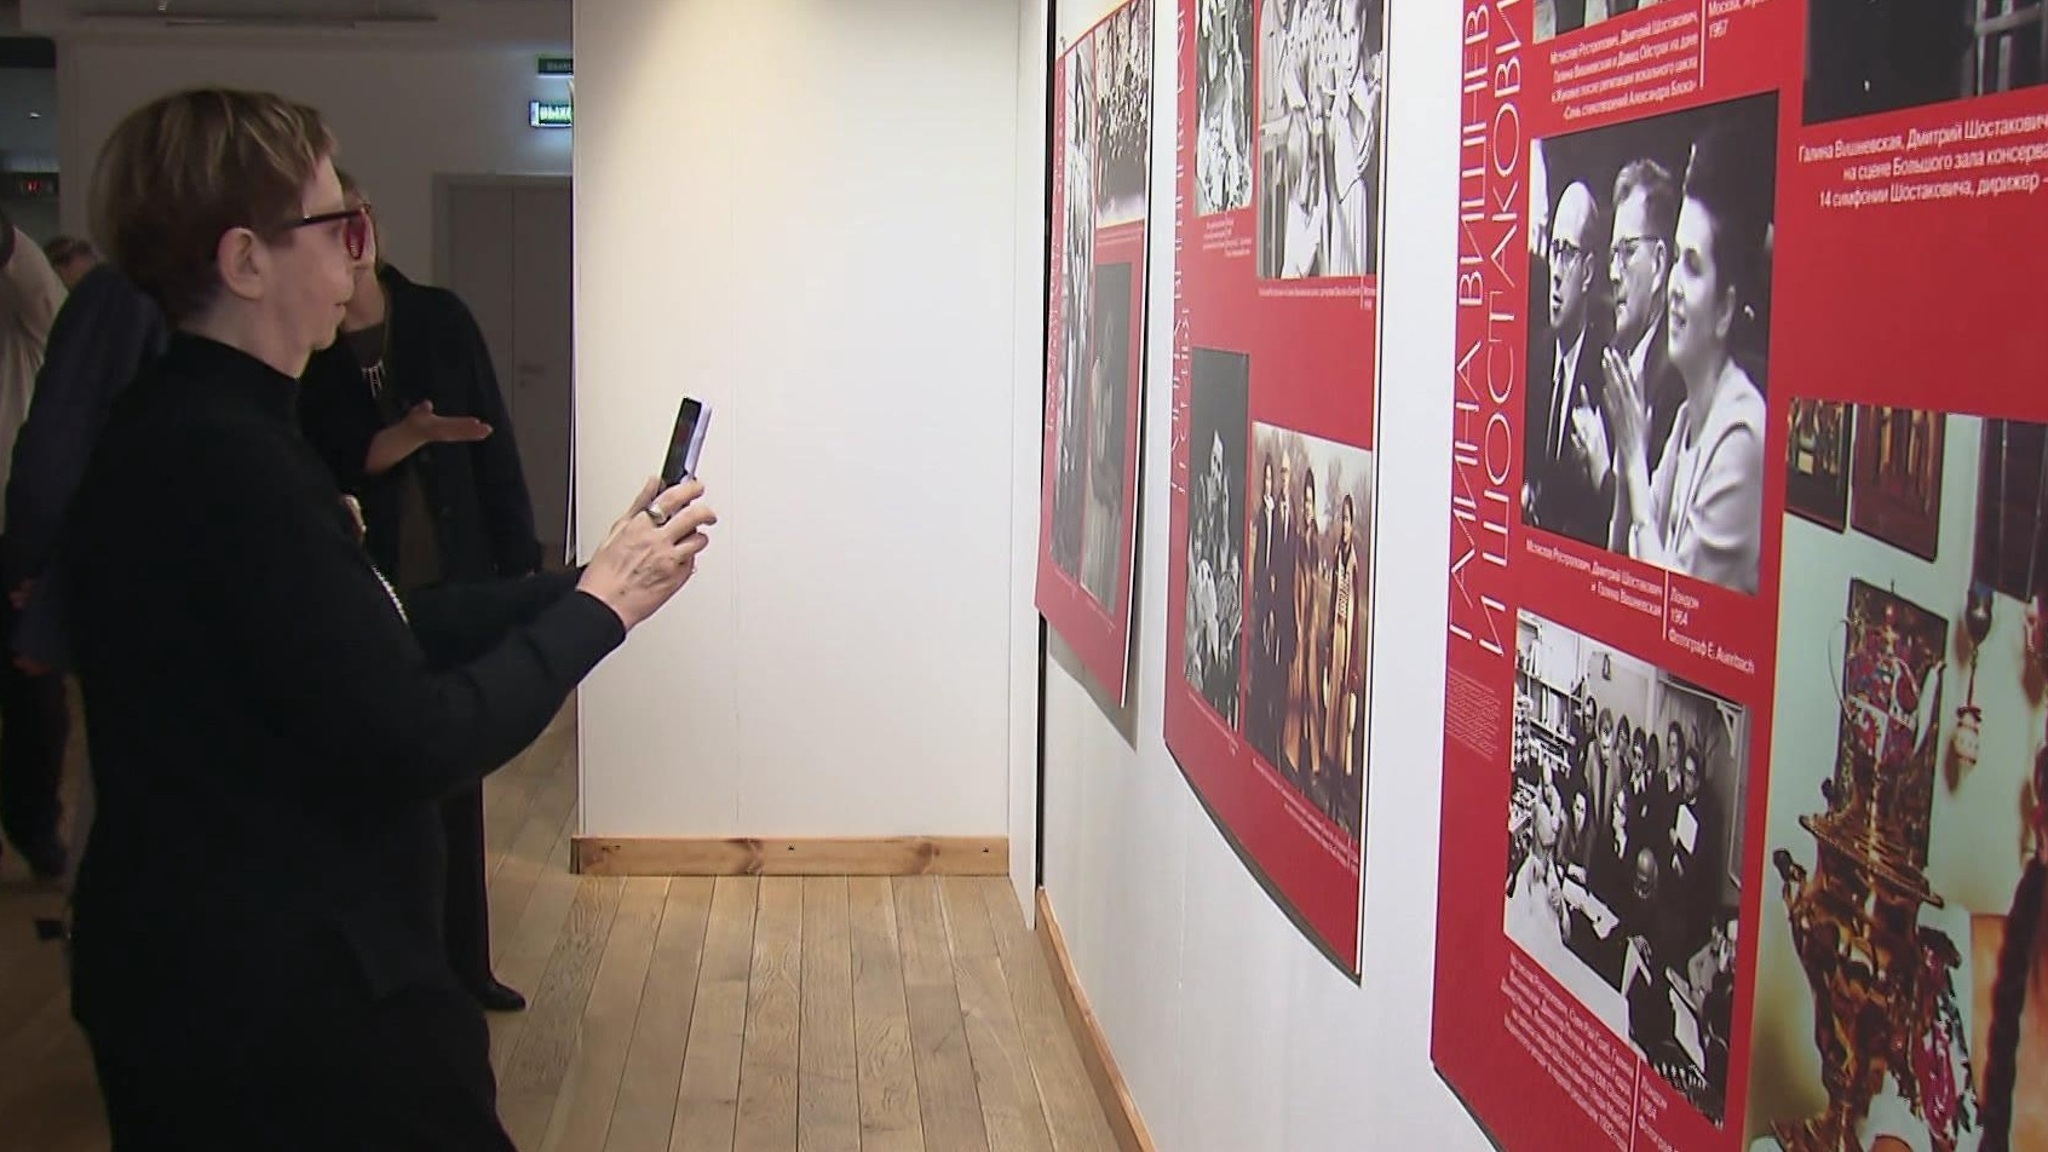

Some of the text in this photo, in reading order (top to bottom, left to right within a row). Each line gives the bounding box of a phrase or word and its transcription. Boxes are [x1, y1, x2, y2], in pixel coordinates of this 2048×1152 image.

[1799, 143, 1833, 162] Галина
[1907, 123, 1962, 150] Дмитрий
[1843, 167, 1857, 181] на
[1858, 161, 1892, 181] сцене
[1893, 152, 1953, 176] Большого
[1954, 150, 1985, 169] зала
[1820, 190, 1832, 208] 14
[1832, 187, 1889, 210] симфонии
[1890, 180, 1975, 203] Шостаковича,
